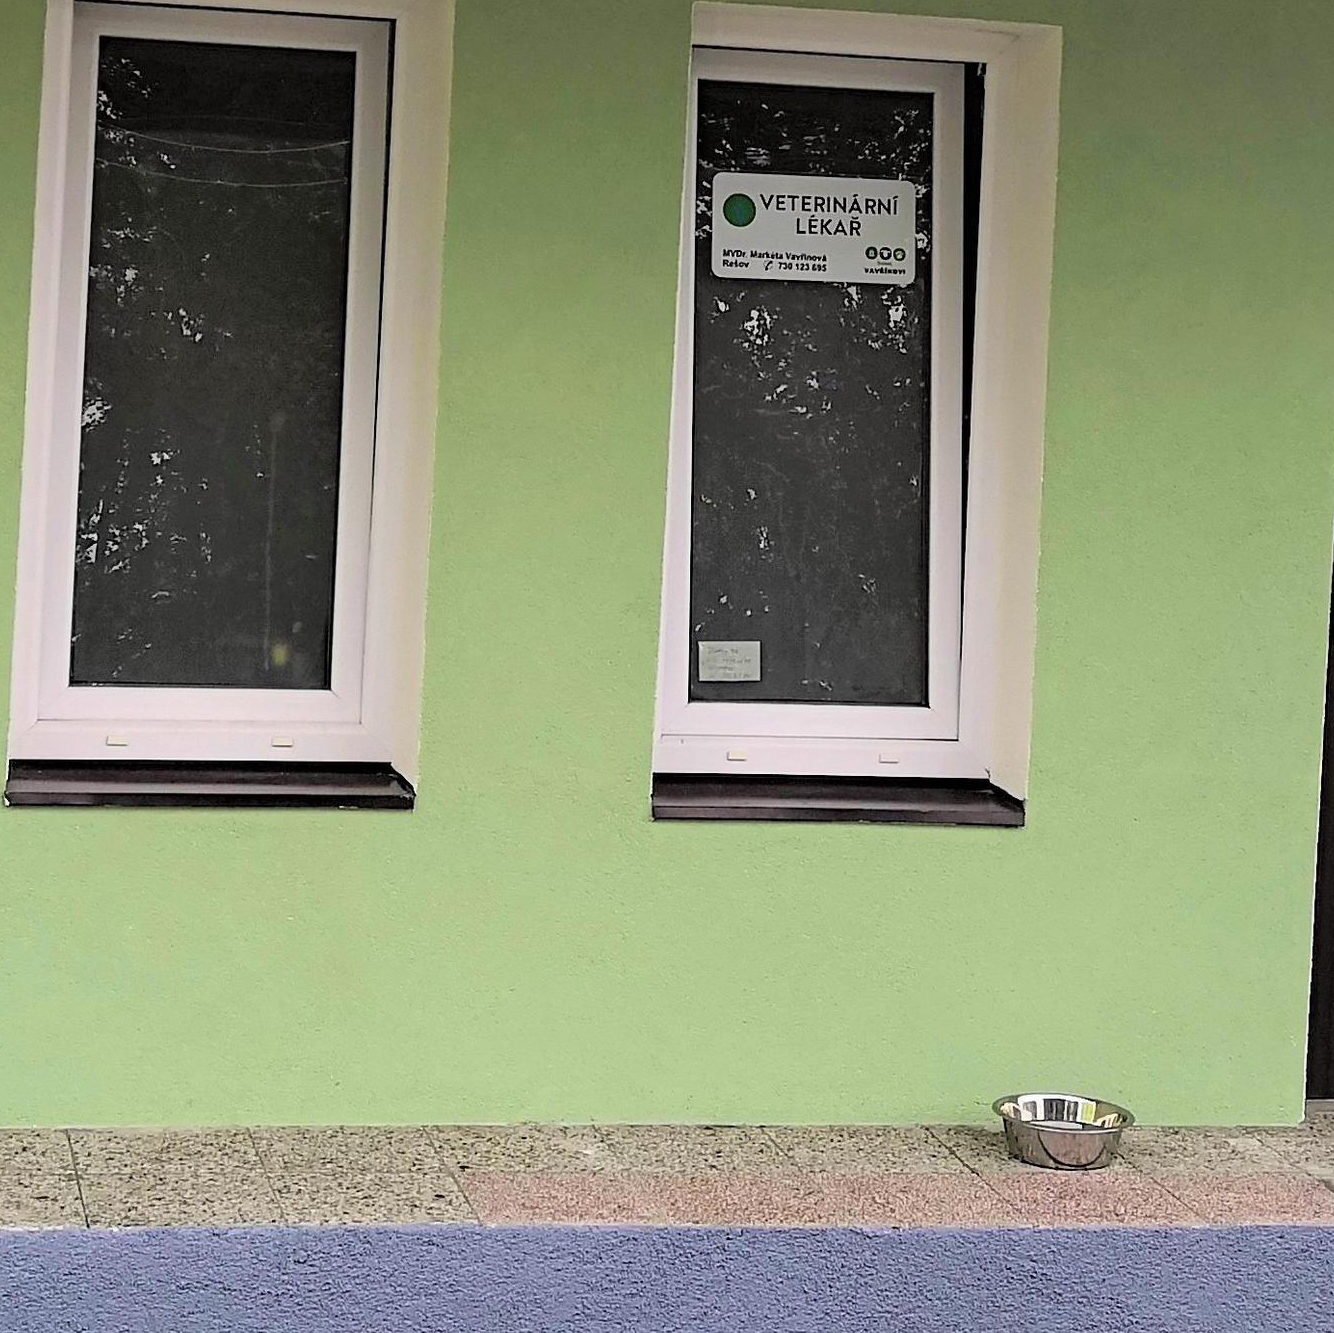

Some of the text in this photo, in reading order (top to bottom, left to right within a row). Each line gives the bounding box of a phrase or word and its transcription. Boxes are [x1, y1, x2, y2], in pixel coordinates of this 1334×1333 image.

[759, 193, 899, 215] VETERINÁRNÍ
[796, 215, 862, 236] LÉKAŘ
[722, 249, 747, 258] MVDr.
[750, 250, 784, 260] Markéta
[722, 259, 750, 268] Rešov
[778, 261, 793, 270] 730
